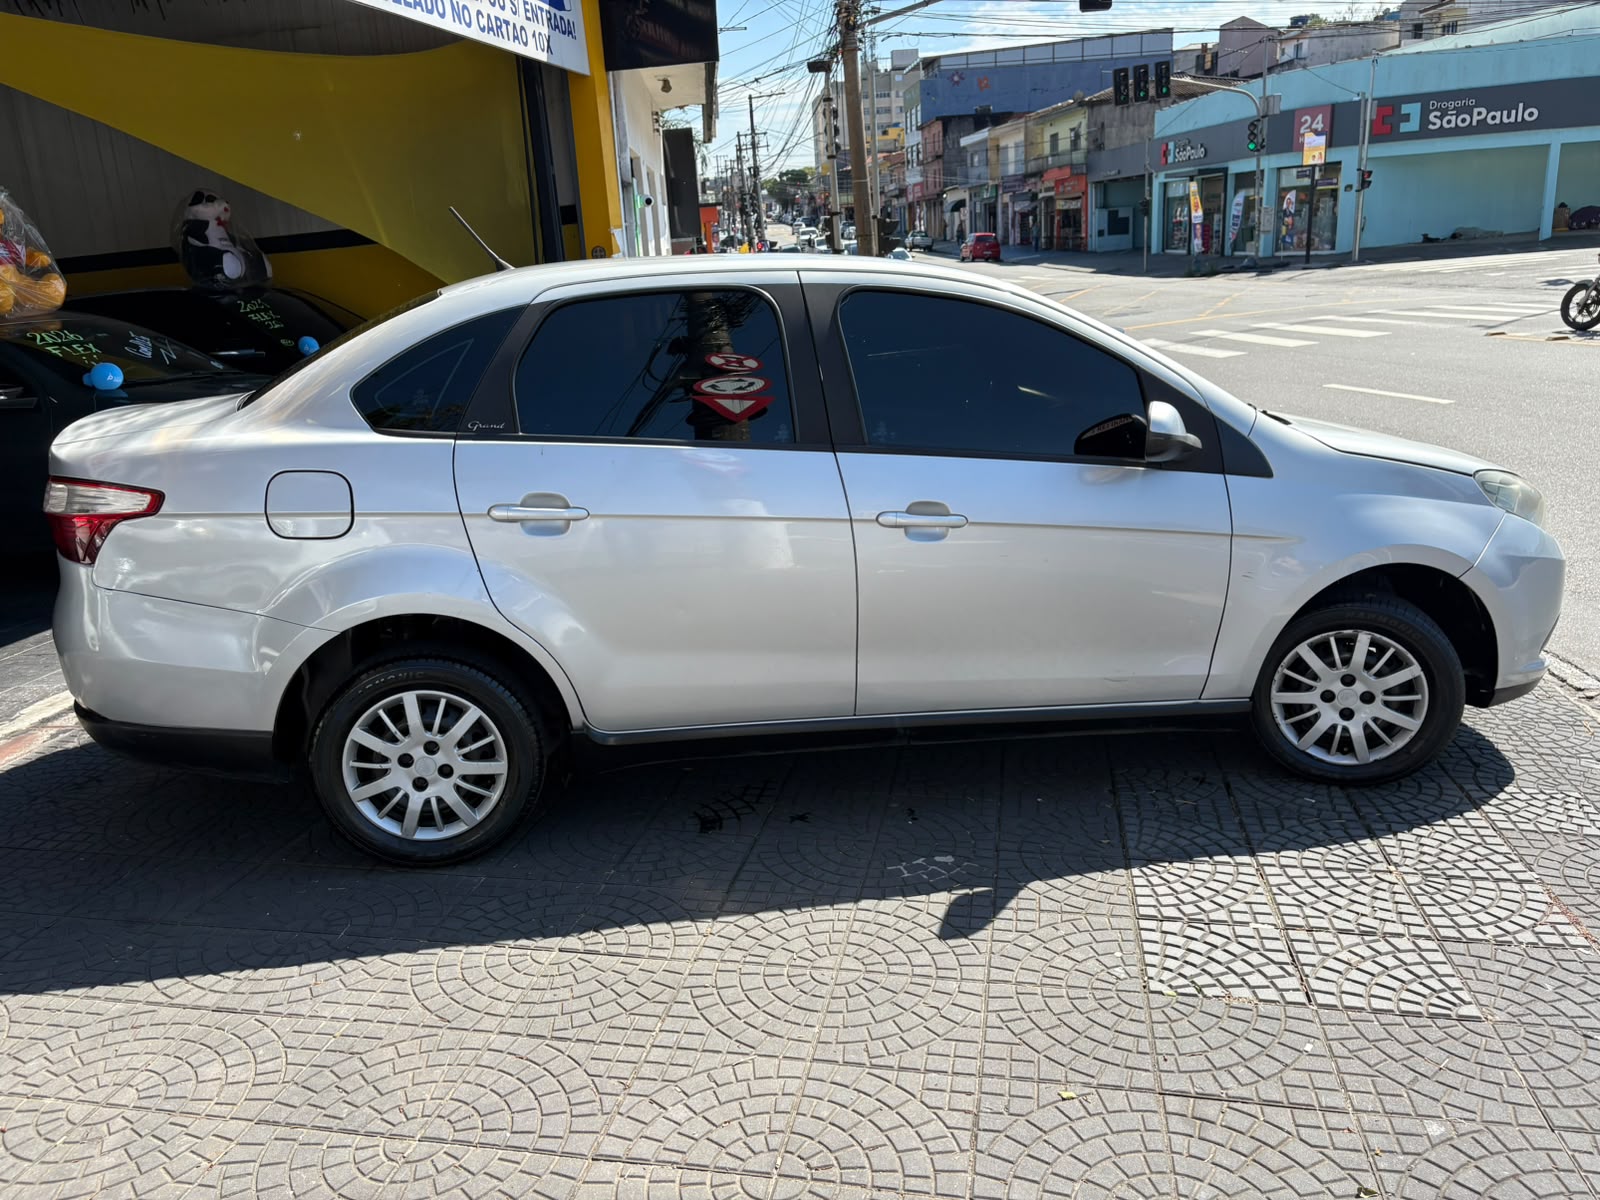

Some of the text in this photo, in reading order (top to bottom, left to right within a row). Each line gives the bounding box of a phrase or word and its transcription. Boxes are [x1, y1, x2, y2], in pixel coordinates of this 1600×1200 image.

[450, 0, 472, 29] NO
[532, 30, 554, 55] 10X
[523, 1, 577, 40] ENTRADA!
[1429, 97, 1476, 110] Drogaria
[1299, 113, 1324, 134] 24
[45, 342, 102, 357] FLEX
[467, 420, 506, 431] Grand
